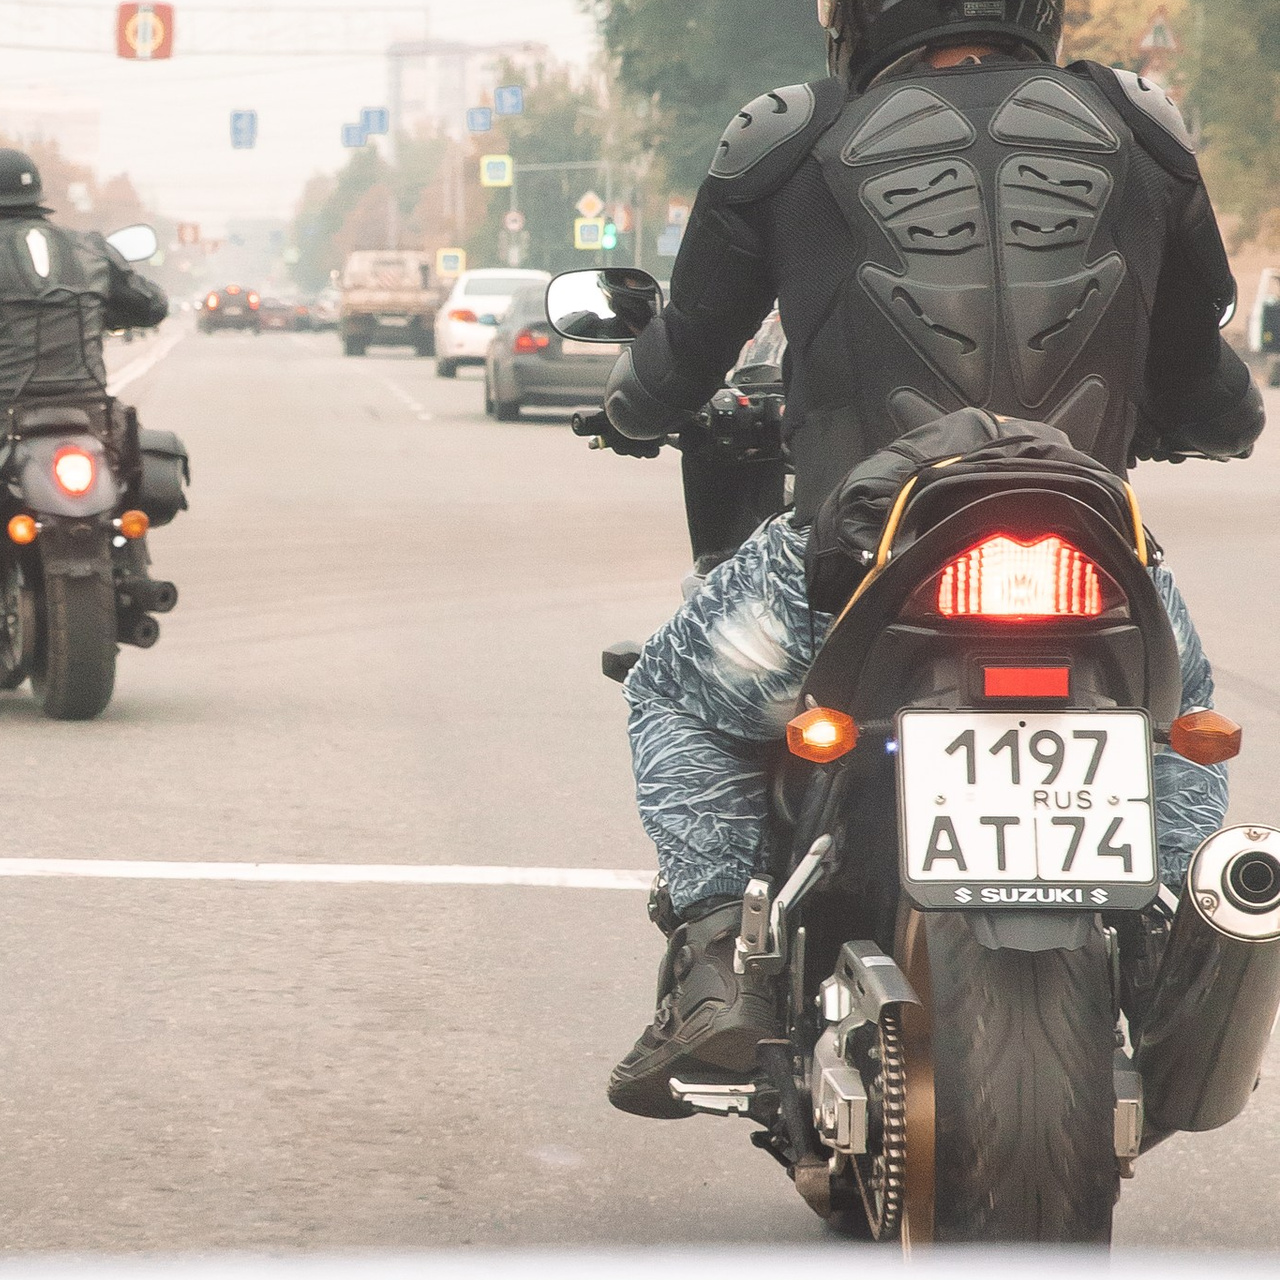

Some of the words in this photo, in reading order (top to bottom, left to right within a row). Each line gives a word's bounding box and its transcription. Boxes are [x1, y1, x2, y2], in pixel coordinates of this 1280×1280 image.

[944, 729, 1108, 785] 1197
[1032, 790, 1093, 810] RUS
[921, 815, 1020, 871] AT
[1050, 816, 1133, 873] 74
[980, 888, 1083, 903] SUZUKI
